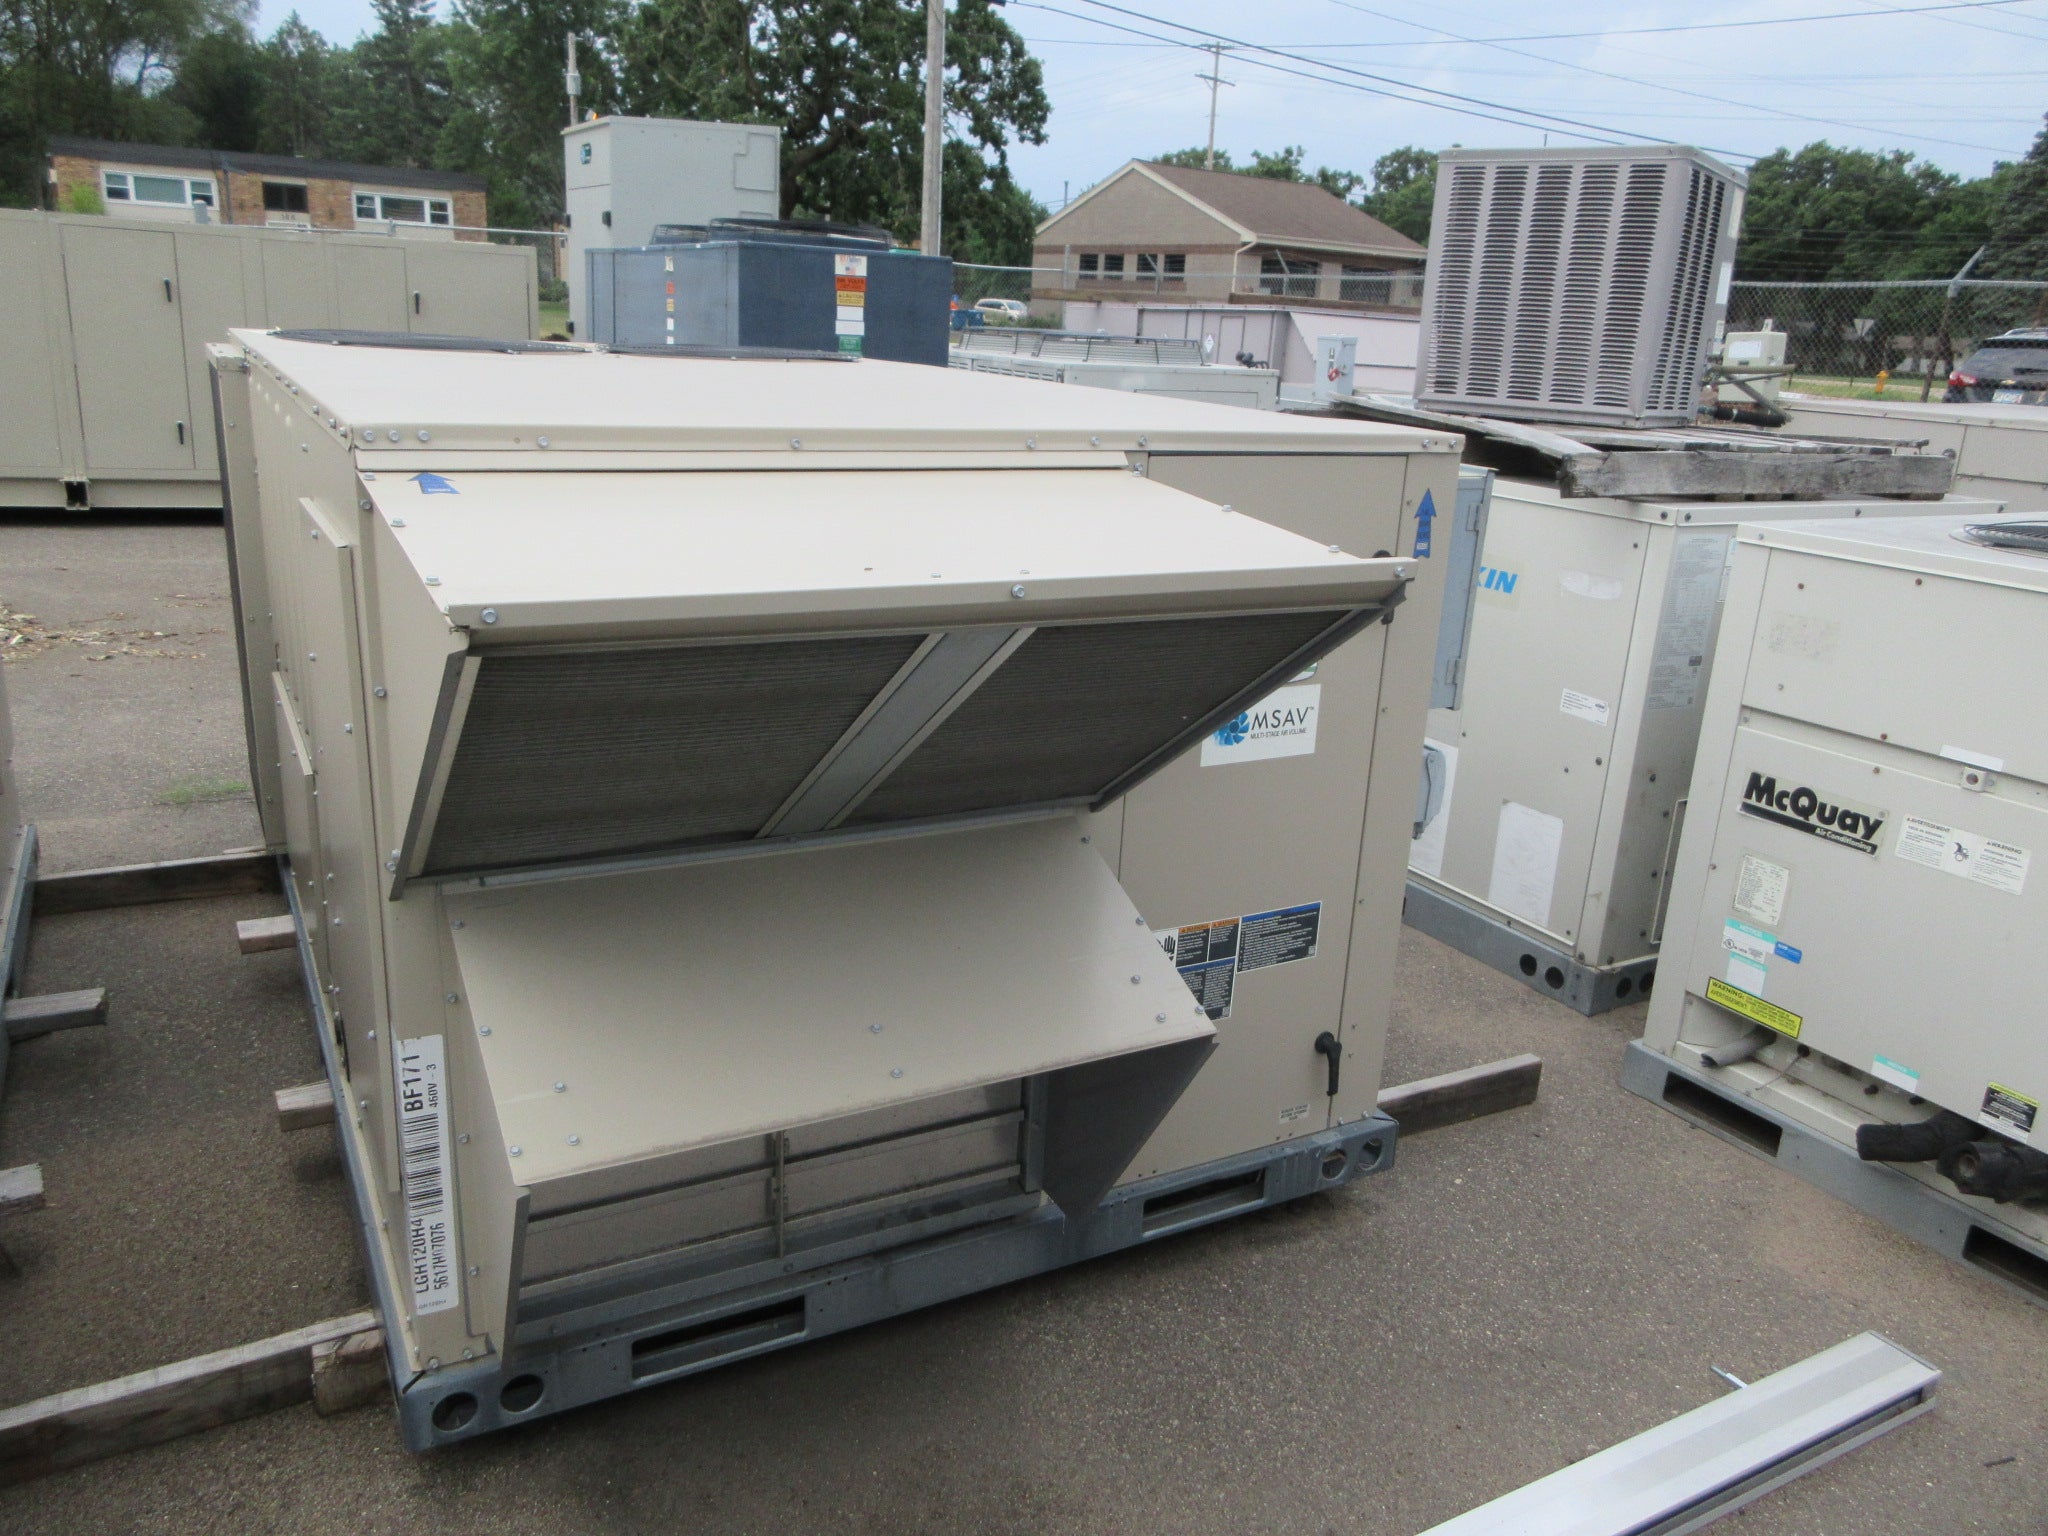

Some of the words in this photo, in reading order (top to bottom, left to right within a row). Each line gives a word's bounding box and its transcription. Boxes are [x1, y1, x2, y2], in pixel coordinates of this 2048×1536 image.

[1743, 771, 1884, 841] McQuay
[1814, 826, 1827, 836] Air
[1826, 830, 1873, 853] Conditioning
[402, 1054, 424, 1113] BF171
[425, 1063, 438, 1072] 3
[427, 1083, 439, 1108] 460V
[411, 1218, 430, 1294] LGH120H4
